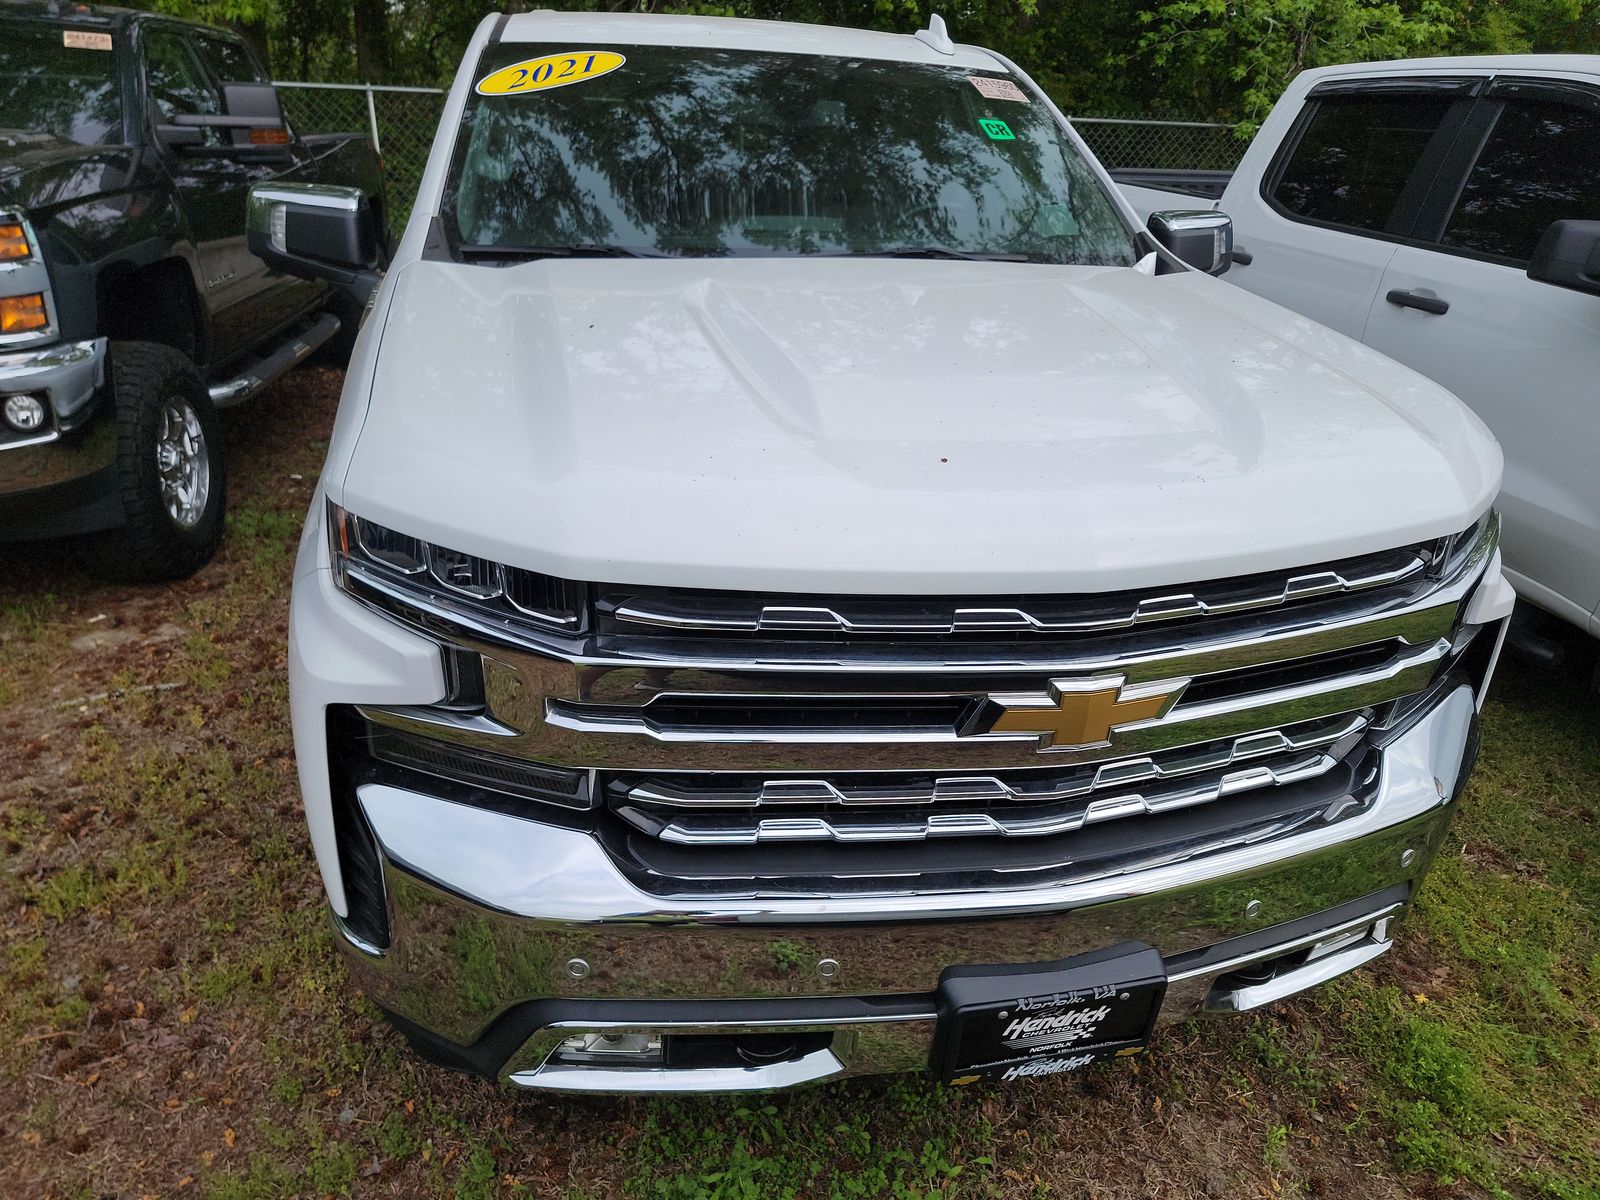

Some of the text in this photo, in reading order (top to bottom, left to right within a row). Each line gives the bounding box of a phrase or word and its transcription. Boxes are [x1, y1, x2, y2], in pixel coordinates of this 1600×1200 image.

[507, 55, 596, 90] 2021
[985, 123, 1011, 136] CR
[1093, 984, 1116, 1000] VA
[1002, 1005, 1111, 1040] Hendrick
[1022, 1023, 1092, 1038] CHEVROLET
[1029, 1041, 1073, 1053] NORFOLK
[1001, 1054, 1095, 1082] Hendrick
